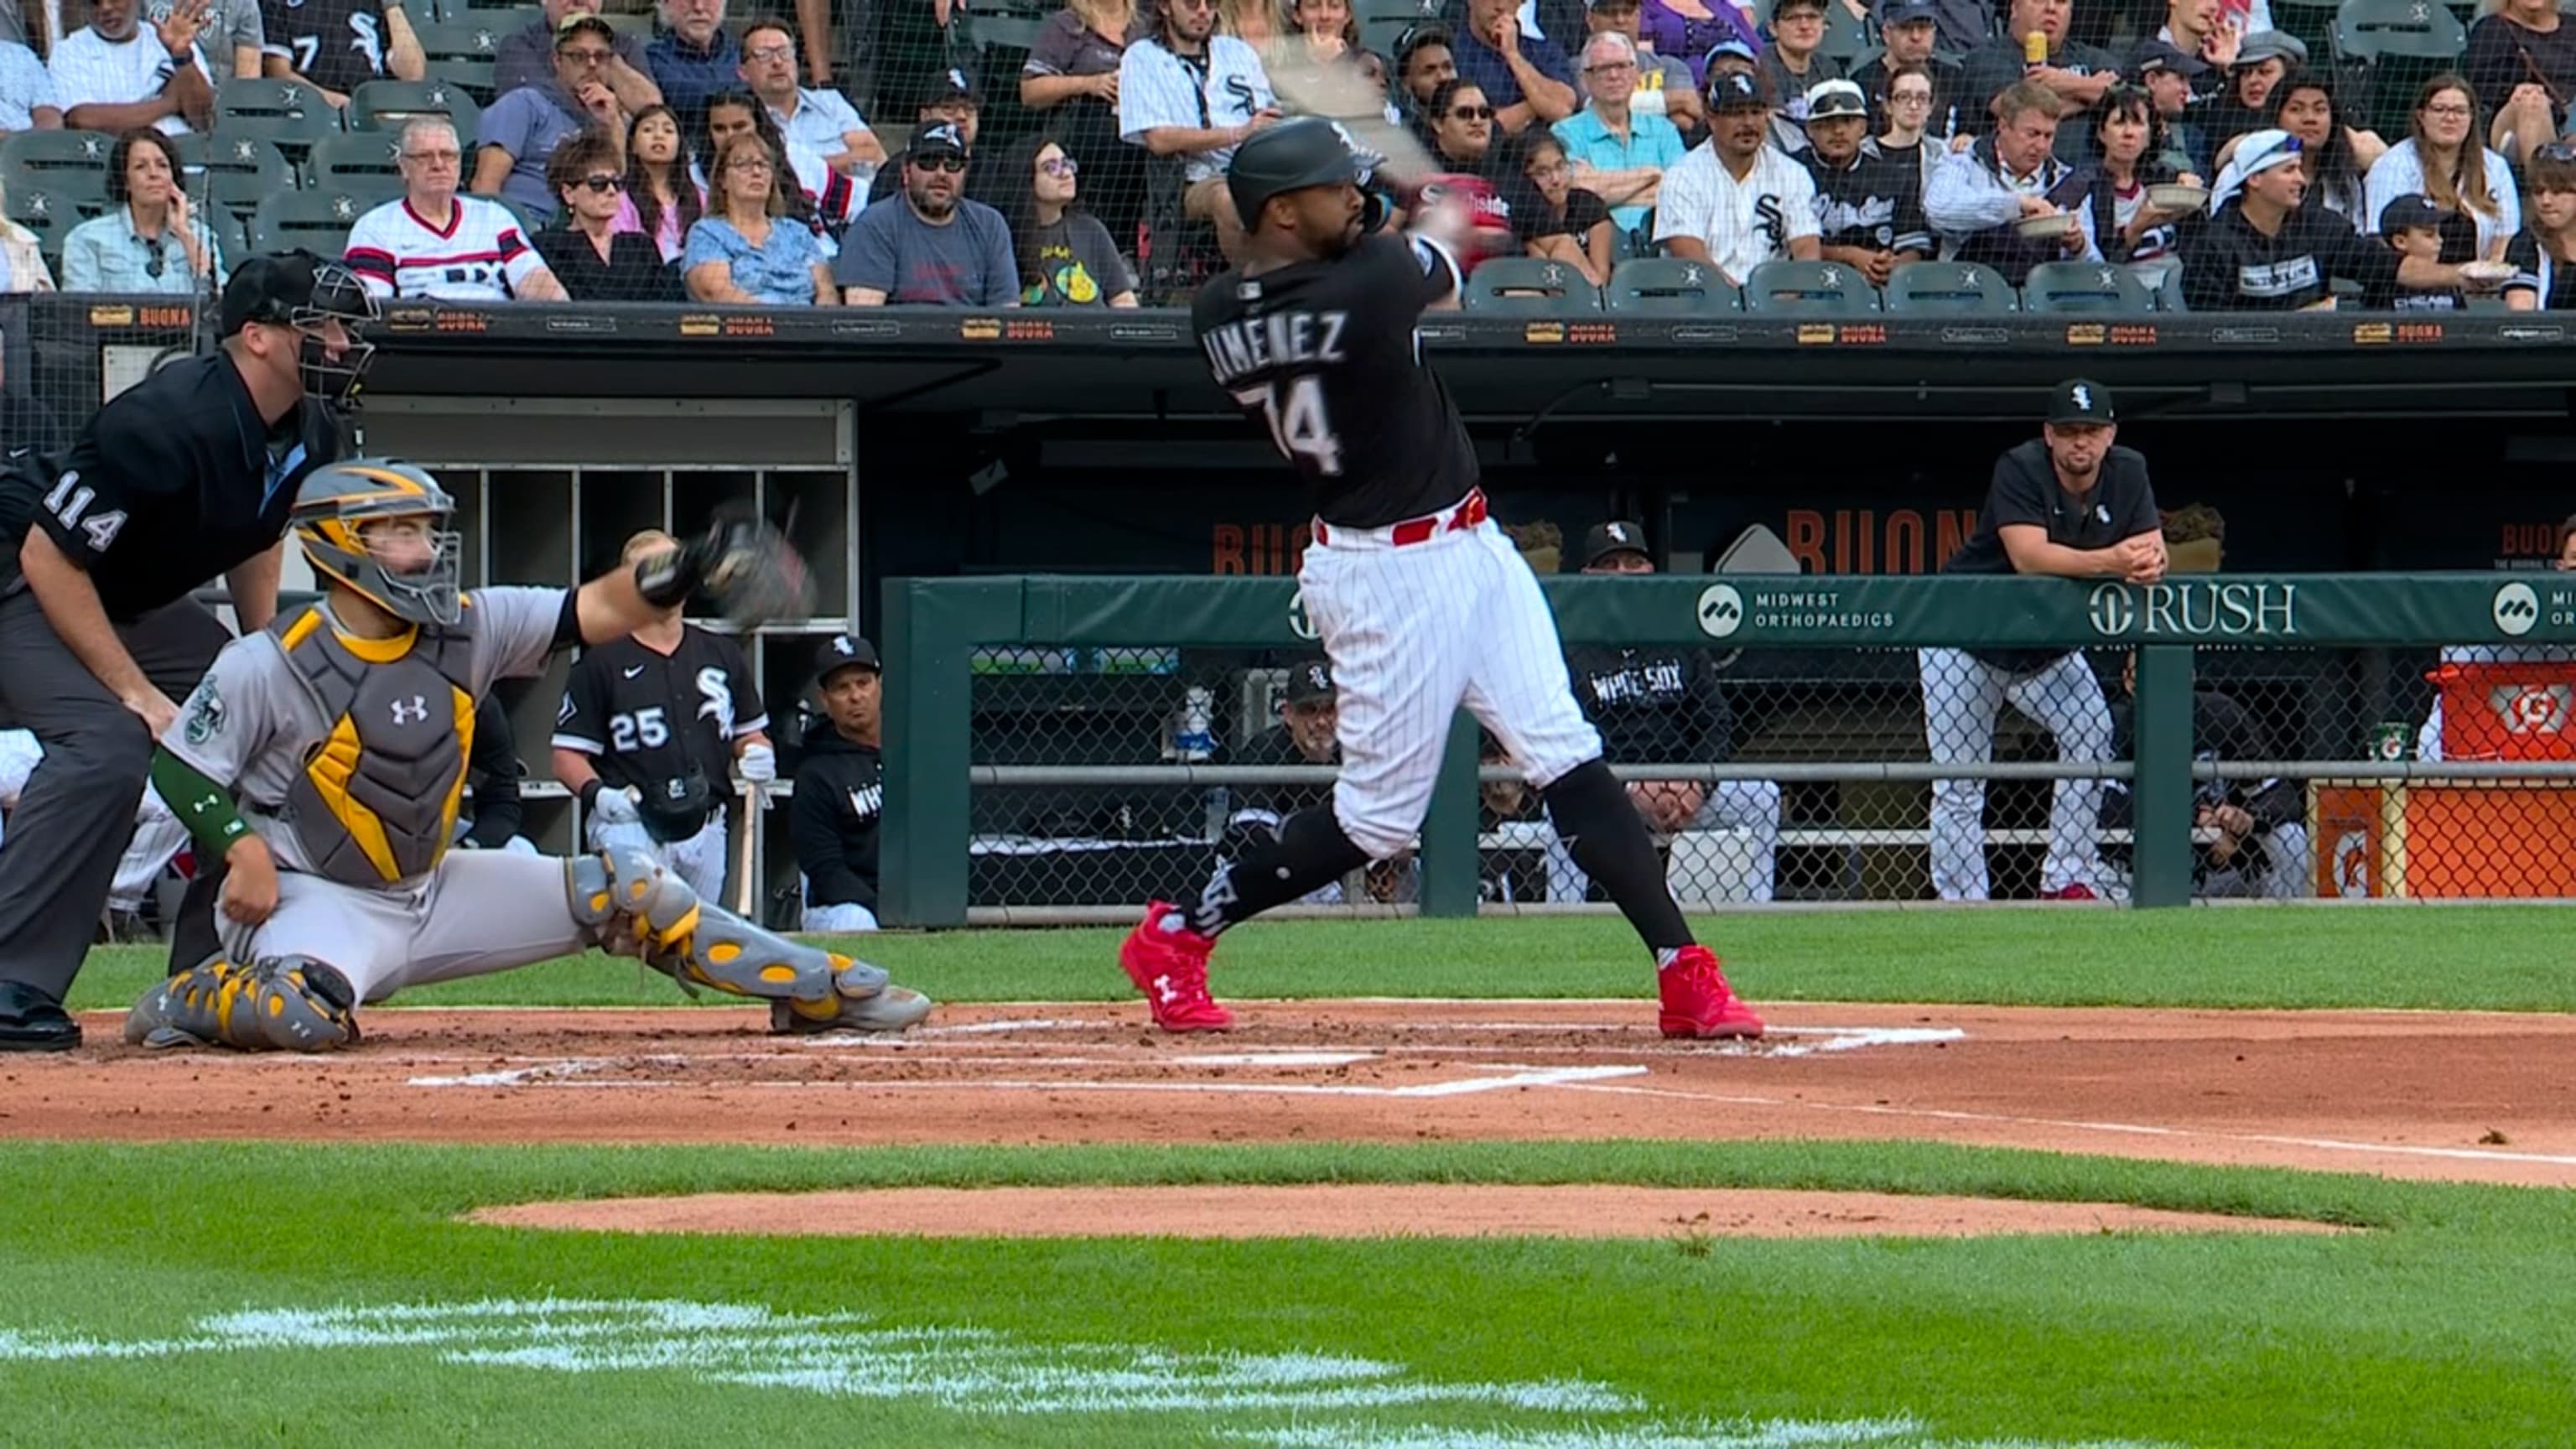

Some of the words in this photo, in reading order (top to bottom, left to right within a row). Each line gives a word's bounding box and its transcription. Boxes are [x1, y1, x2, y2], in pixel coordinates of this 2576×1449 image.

[293, 35, 319, 72] 7
[139, 307, 191, 326] BUONA
[1227, 377, 1345, 475] 74
[43, 470, 128, 553] 114
[1756, 592, 1839, 607] MIDWEST
[2144, 584, 2297, 635] RUSH
[1755, 612, 1894, 627] ORTHOPAEDICS
[608, 707, 669, 752] 25
[849, 782, 882, 816] WH
